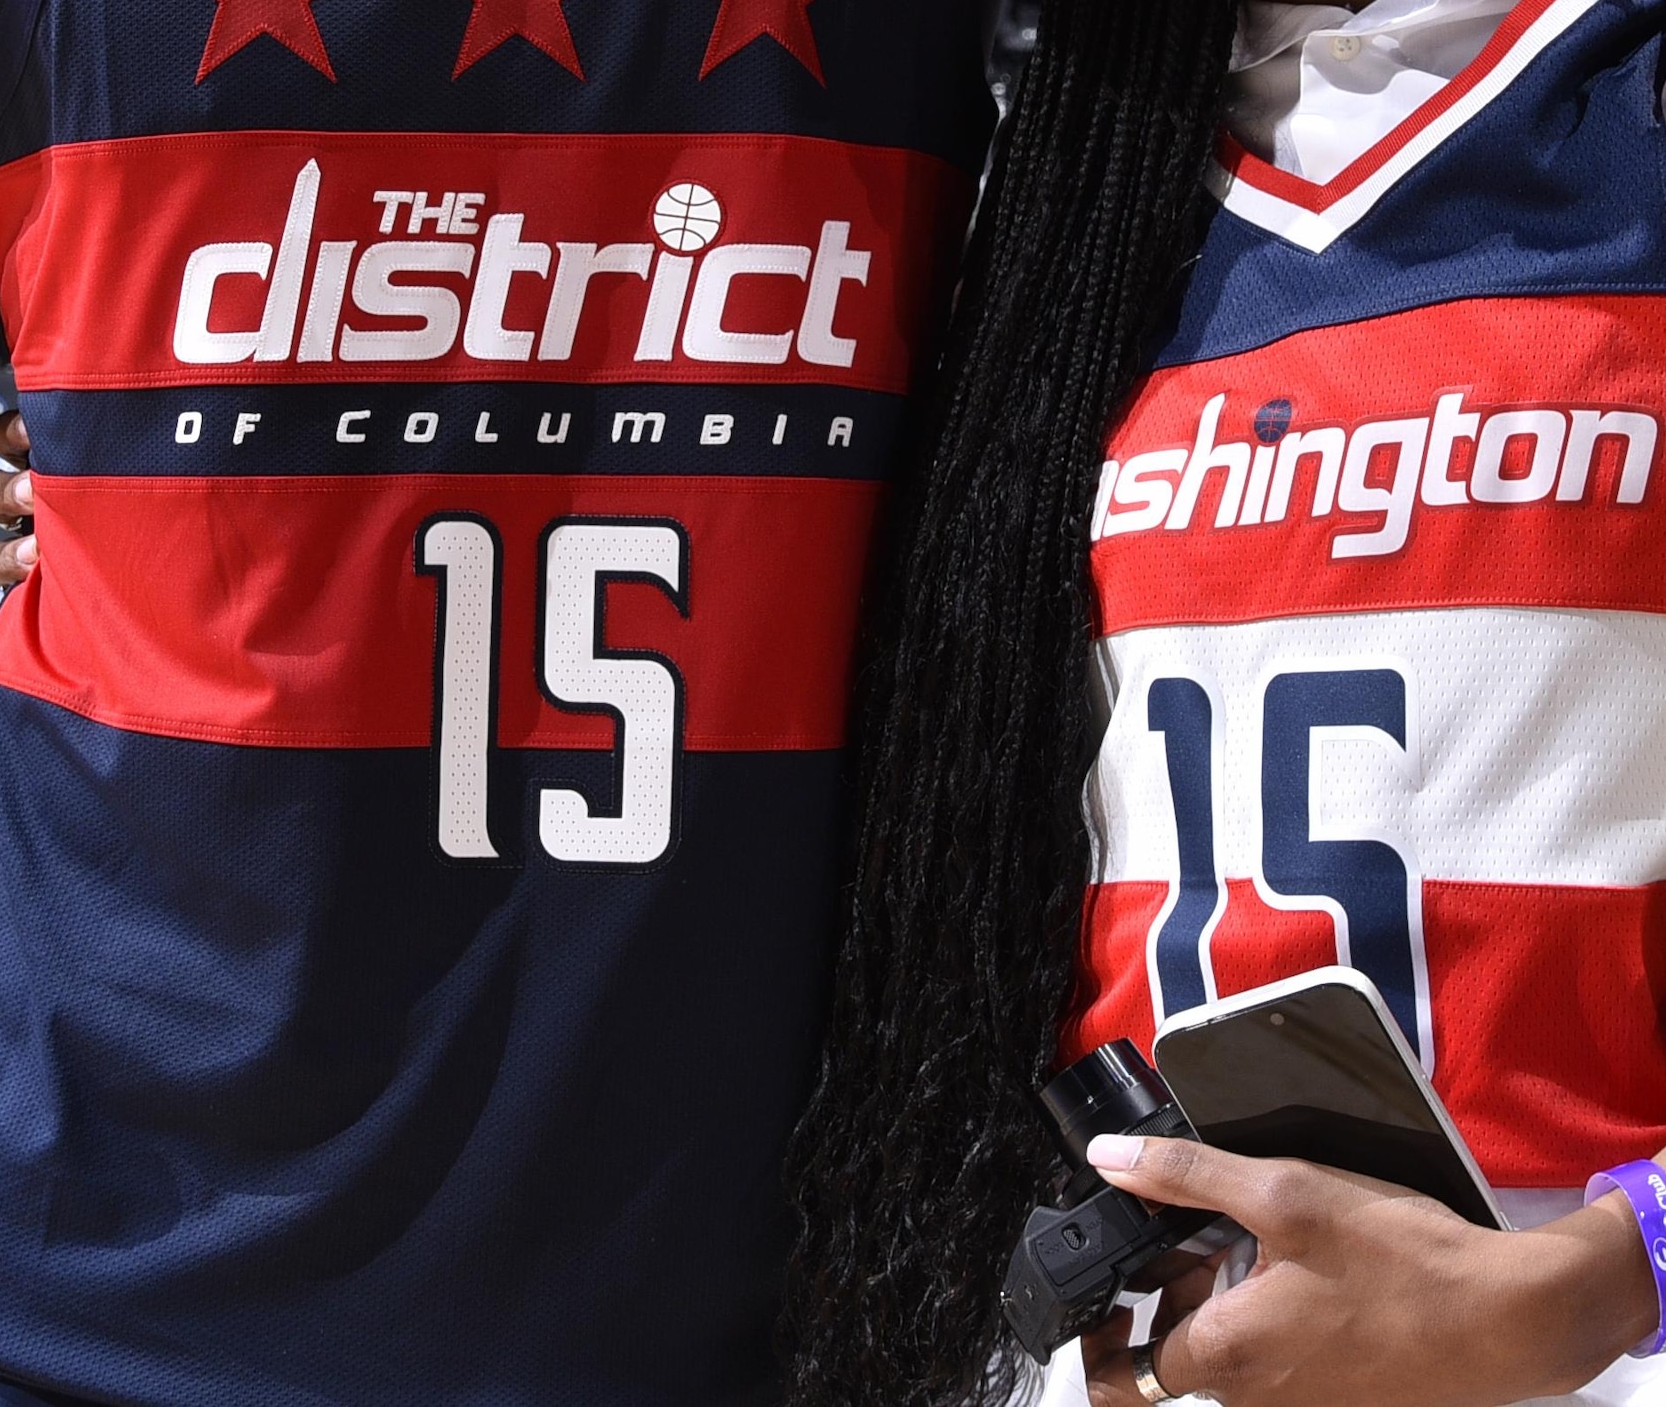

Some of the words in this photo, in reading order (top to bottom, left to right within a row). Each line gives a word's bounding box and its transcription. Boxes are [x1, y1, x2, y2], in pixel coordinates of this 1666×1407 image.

[171, 157, 873, 369] district
[371, 189, 487, 236] THE
[173, 409, 262, 446] OF
[335, 408, 855, 449] COLUMBIA
[1090, 392, 1659, 561] shington
[417, 513, 690, 871] 15
[1145, 665, 1433, 1069] 15
